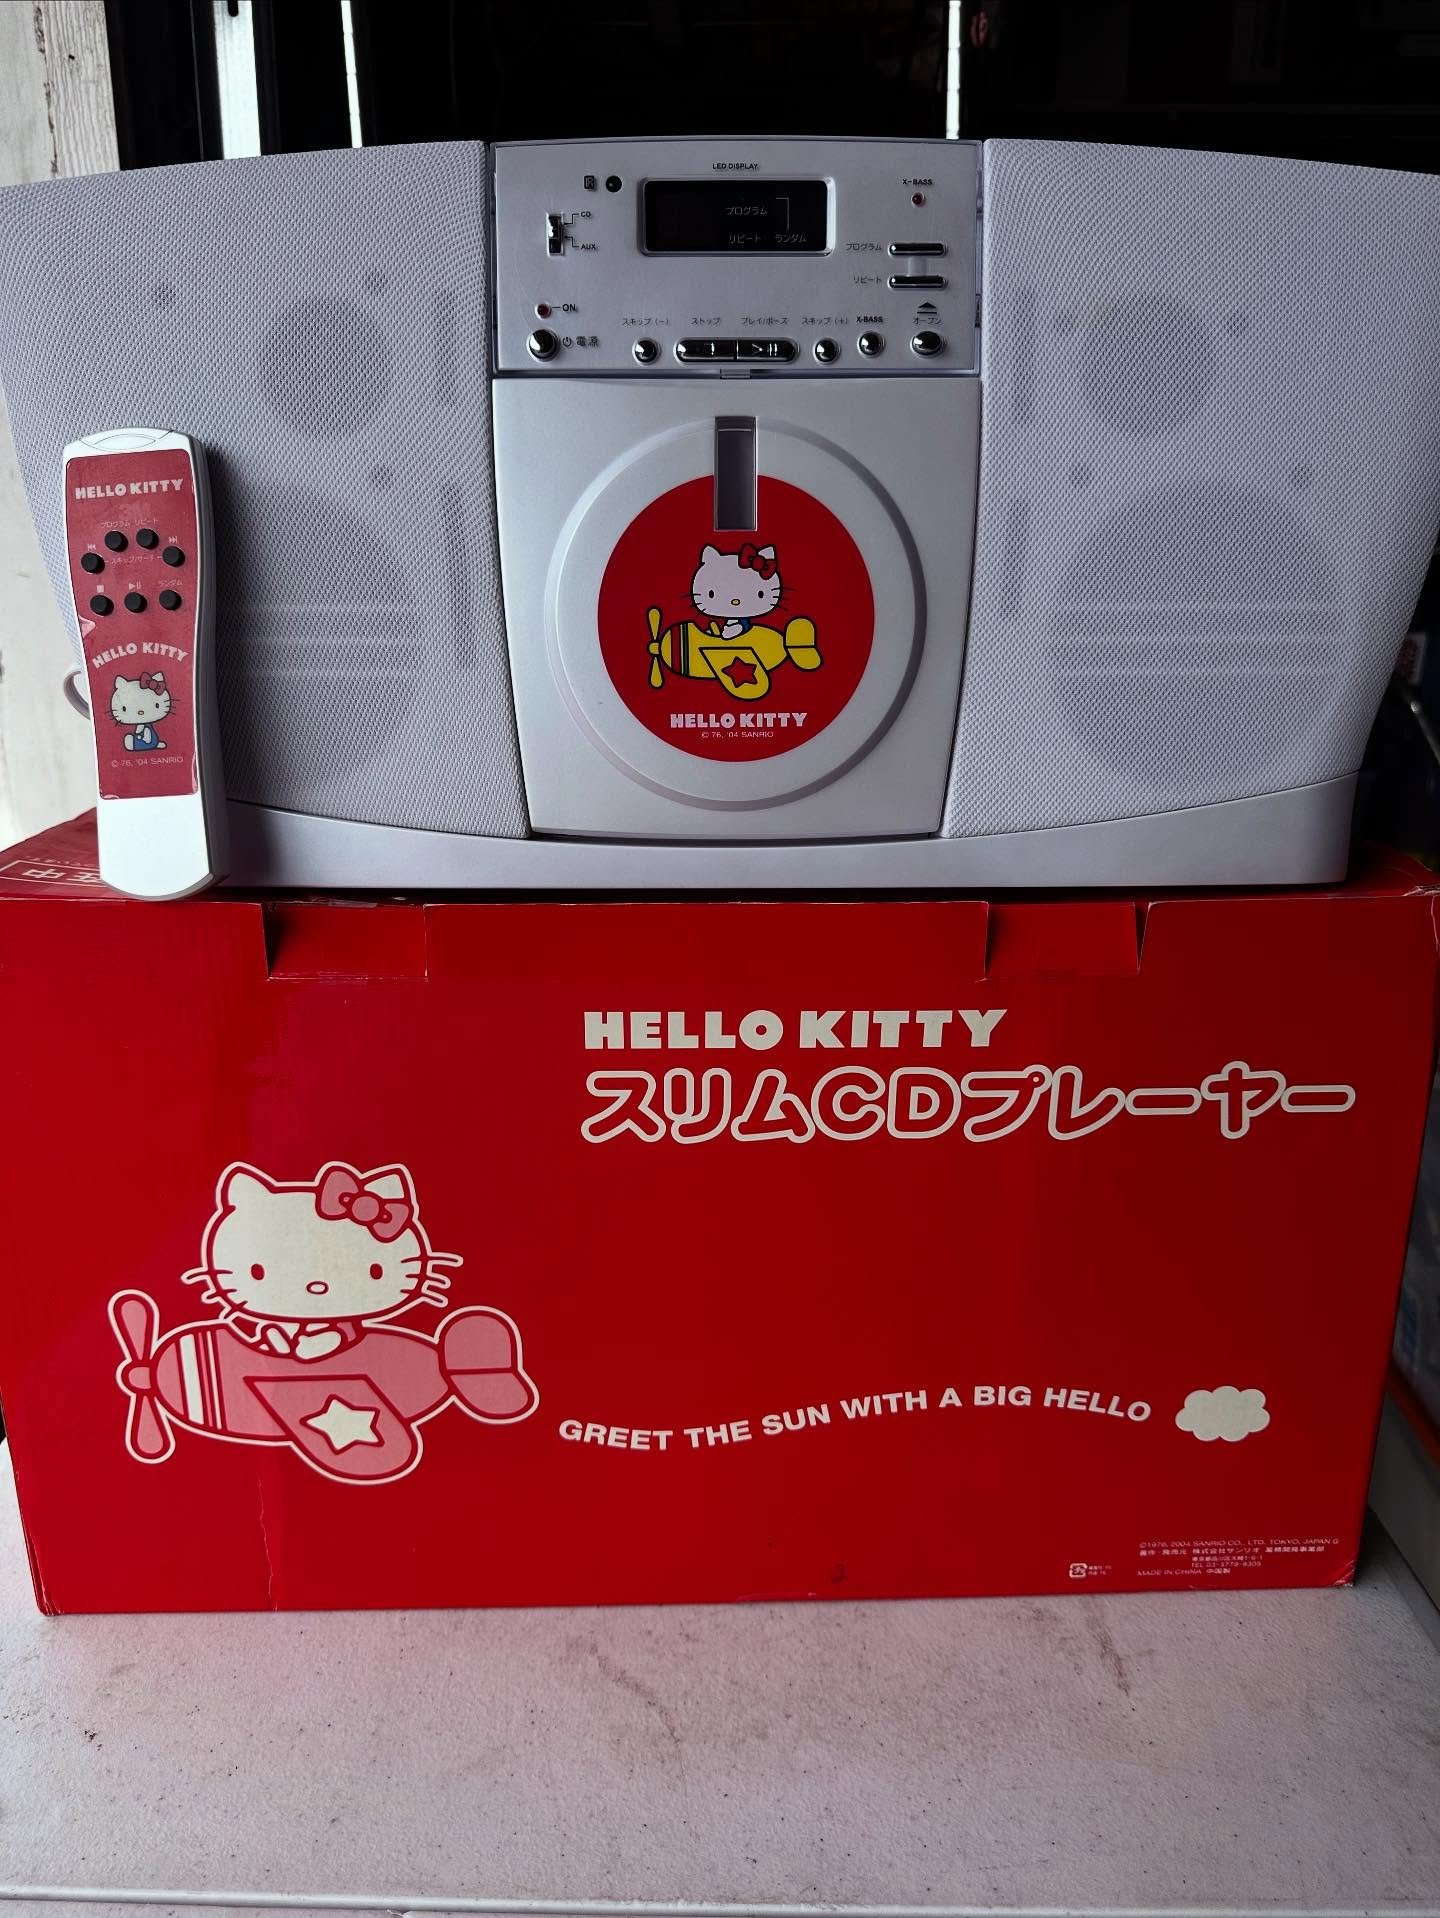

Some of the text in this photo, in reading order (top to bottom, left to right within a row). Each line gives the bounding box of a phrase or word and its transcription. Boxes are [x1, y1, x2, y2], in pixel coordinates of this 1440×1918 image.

[712, 162, 759, 170] LED DISPLAY
[902, 178, 933, 186] X-BASS
[725, 206, 768, 216] プログラム
[846, 242, 882, 251] プログラム
[562, 303, 577, 312] ON
[691, 317, 721, 325] ストップ
[856, 315, 883, 324] X-BASS
[576, 336, 598, 347] 電源
[75, 478, 184, 500] HELLO KITTY
[91, 642, 189, 669] HELLO KITTY
[670, 712, 808, 729] HELLO KITTY
[150, 756, 184, 765] SANRIO
[584, 1010, 1007, 1050] HELLO KITTY
[581, 1061, 1355, 1144] スリムCDプレーヤー
[560, 1386, 1150, 1450] GREET THE SUN WITH A BIG HELLO
